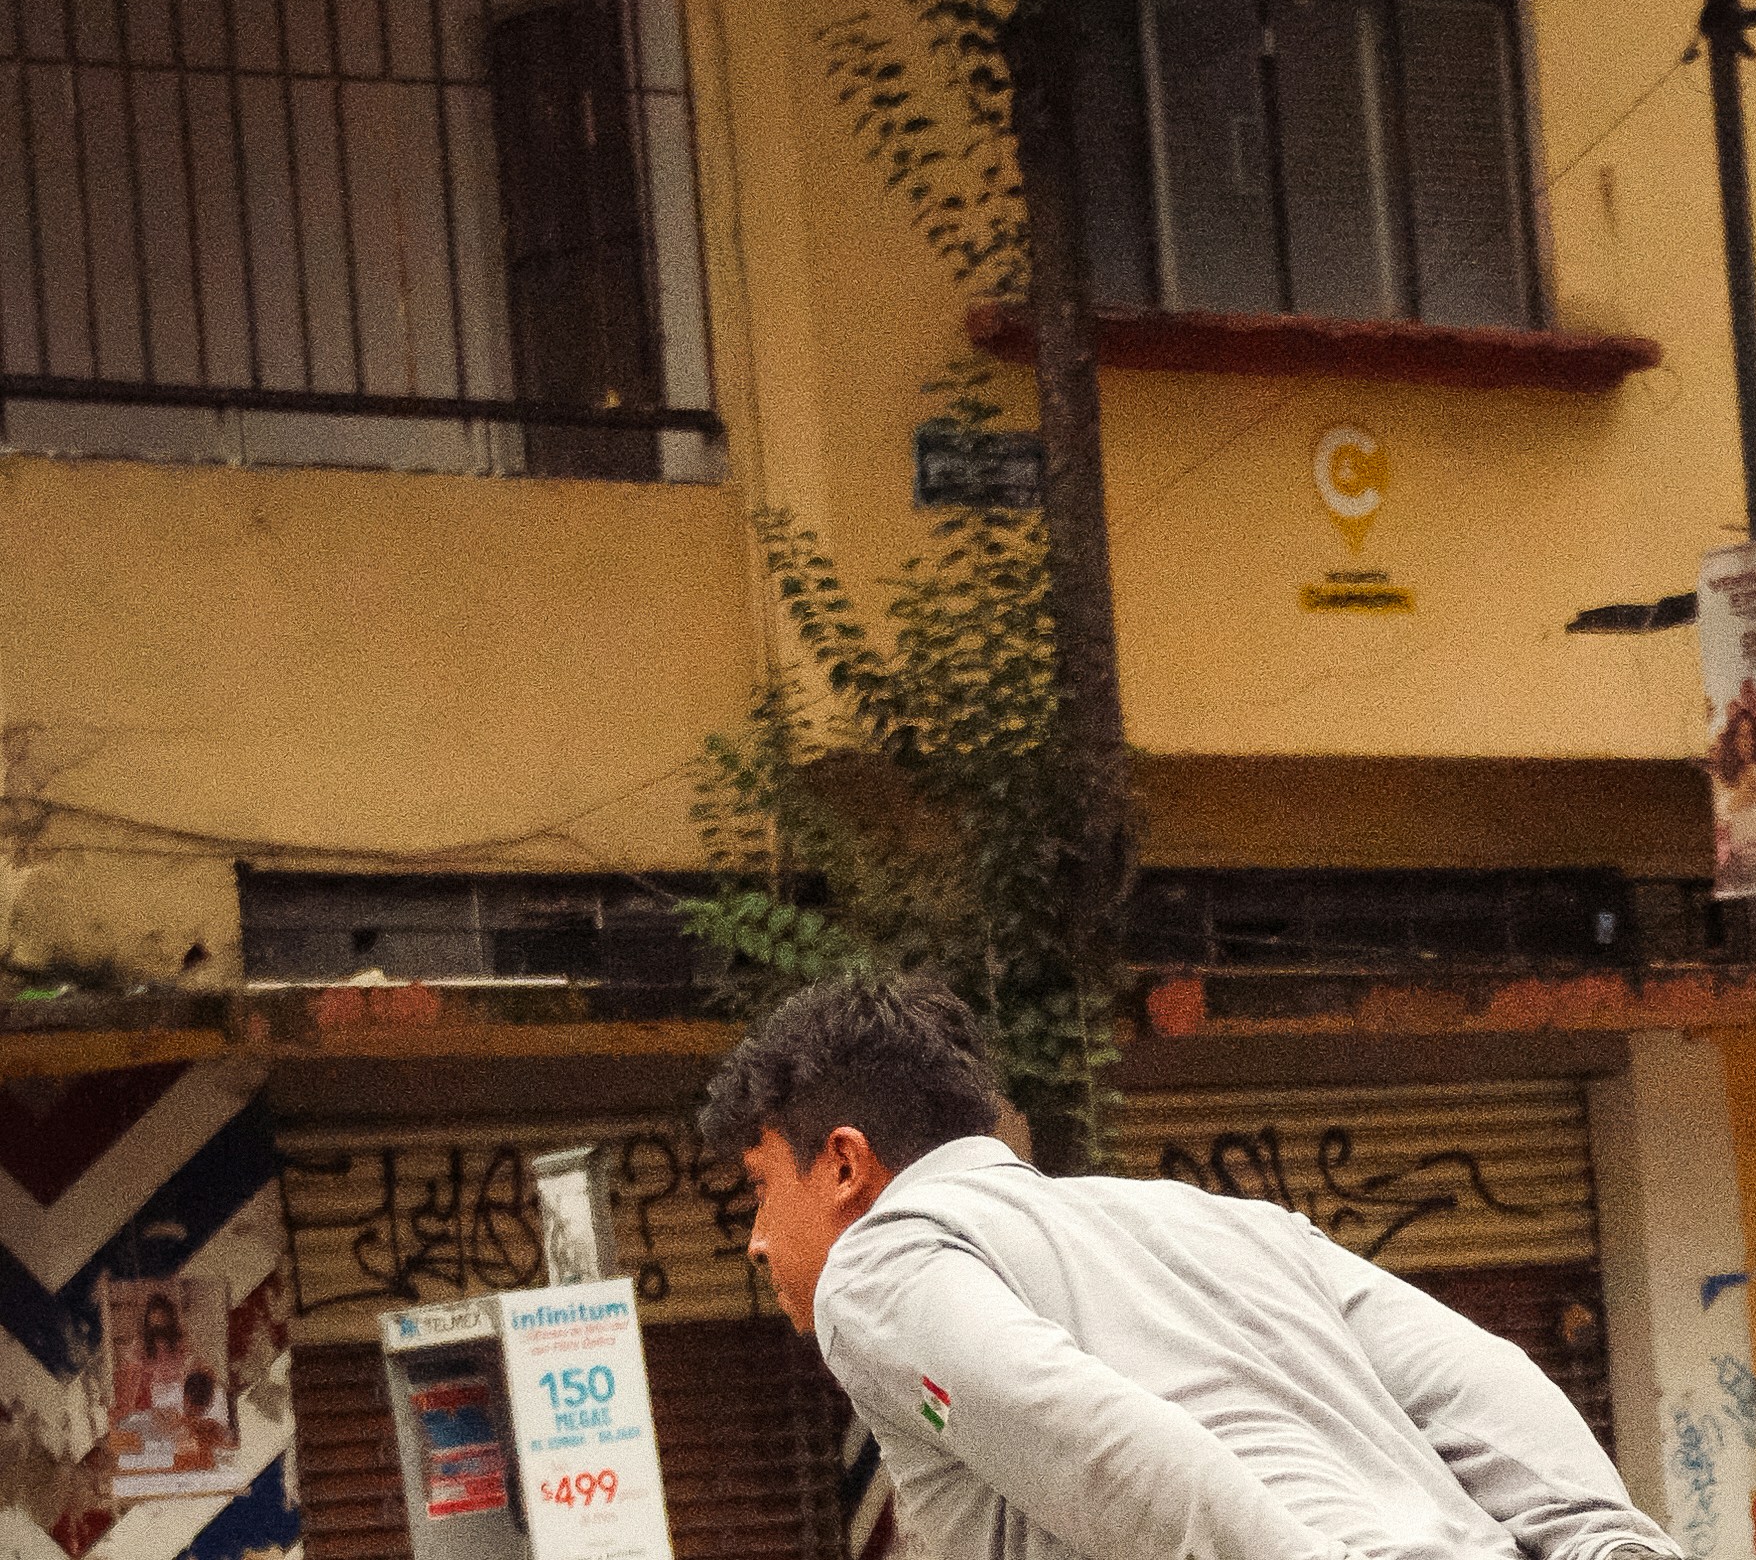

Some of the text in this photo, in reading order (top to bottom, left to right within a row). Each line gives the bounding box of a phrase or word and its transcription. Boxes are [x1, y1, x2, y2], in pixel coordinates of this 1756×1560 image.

[511, 1302, 629, 1331] infinitum
[539, 1364, 616, 1409] 150
[540, 1468, 619, 1509] $499
